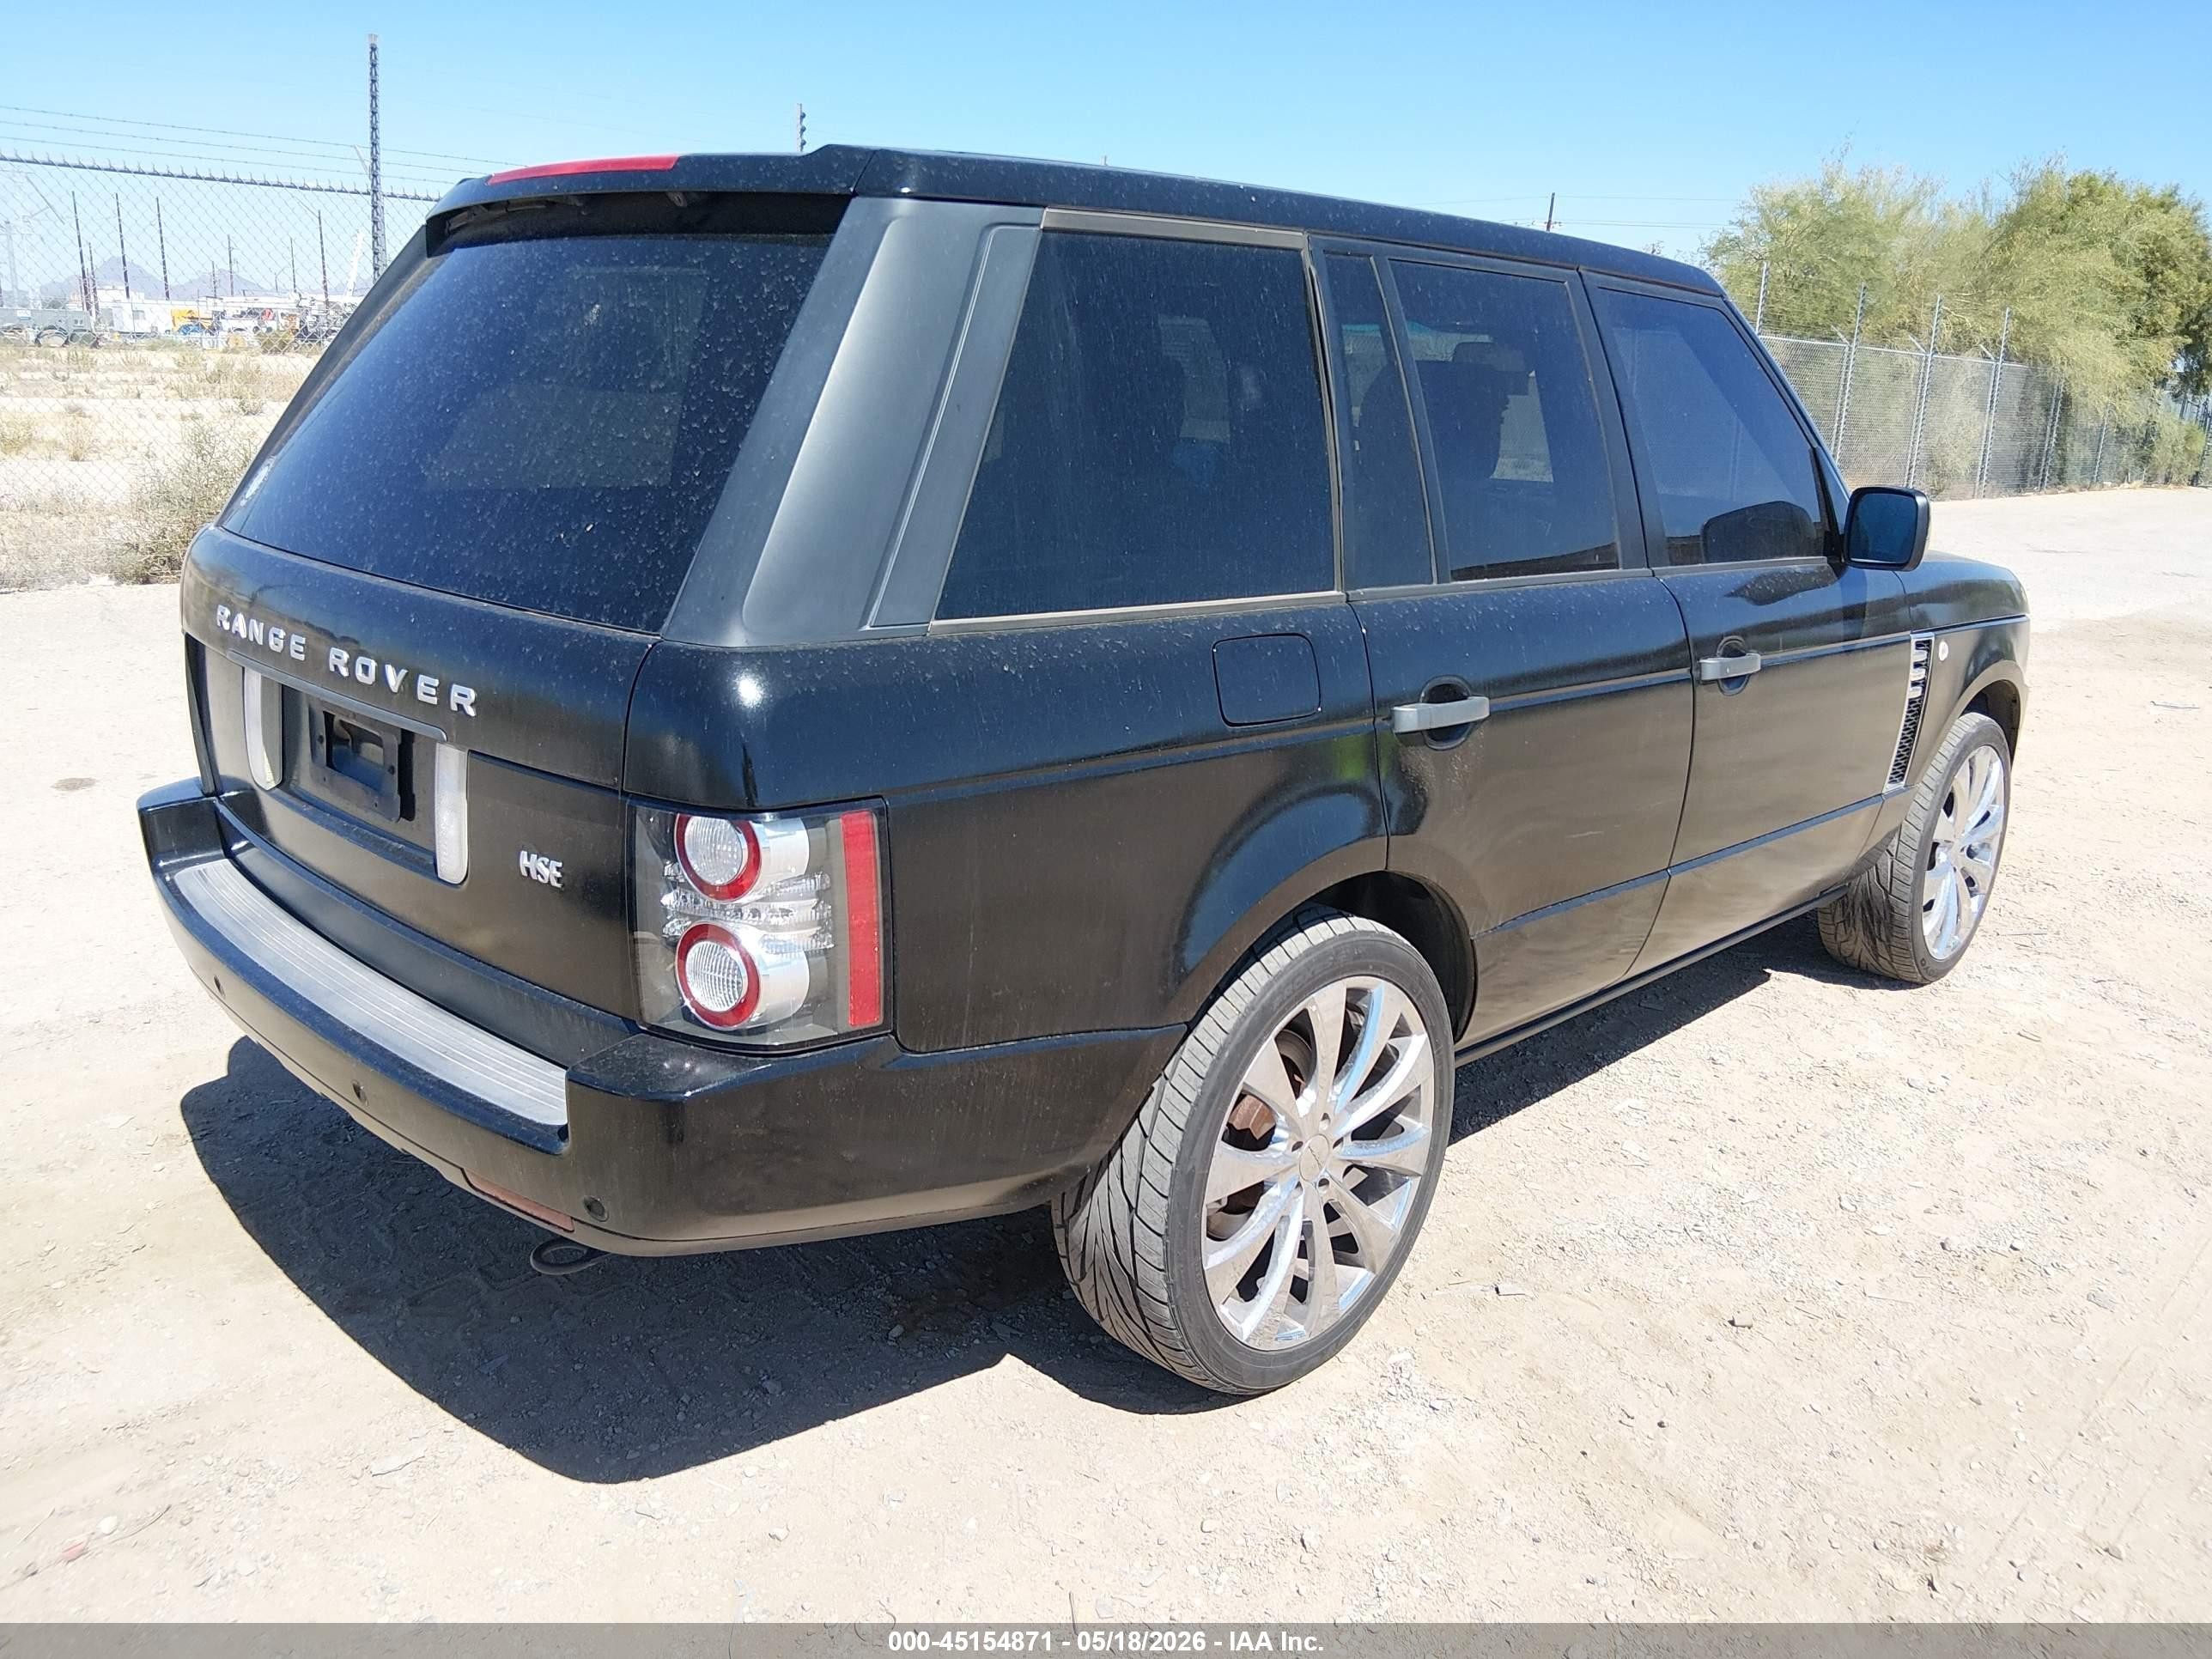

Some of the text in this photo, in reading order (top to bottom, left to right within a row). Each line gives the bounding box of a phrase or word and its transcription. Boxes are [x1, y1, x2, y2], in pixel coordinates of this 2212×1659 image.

[216, 604, 477, 718] RANGE ROVER
[519, 850, 563, 889] HSE
